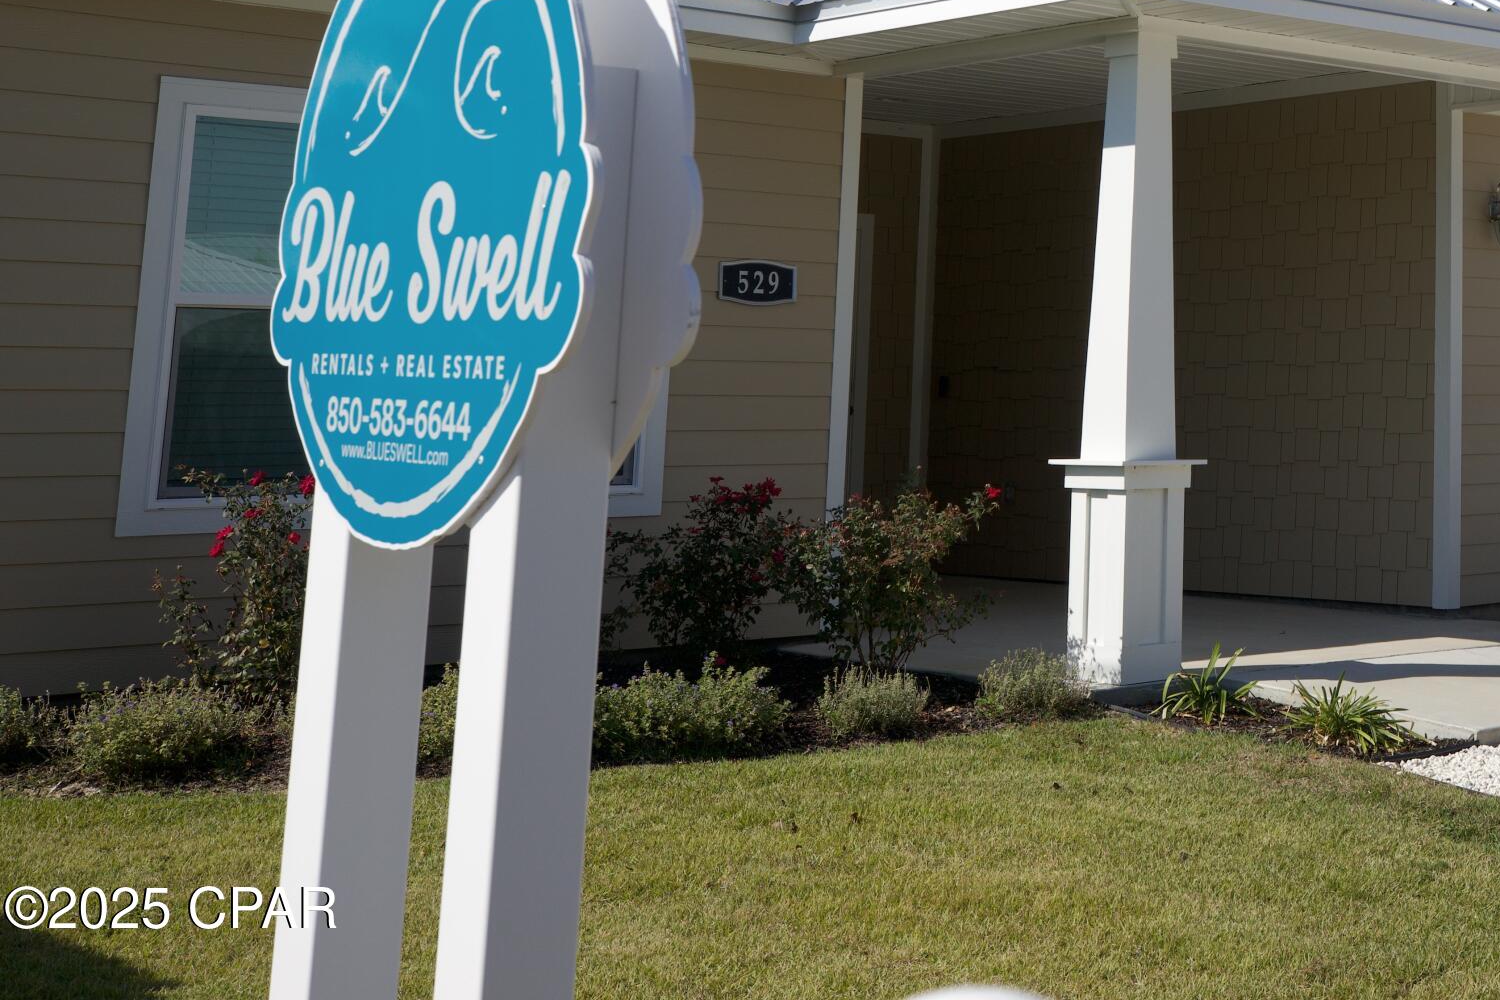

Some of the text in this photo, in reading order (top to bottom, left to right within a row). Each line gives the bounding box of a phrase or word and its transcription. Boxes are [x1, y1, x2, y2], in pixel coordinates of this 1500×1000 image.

[282, 169, 571, 324] Blue Swell
[737, 270, 779, 294] 529
[311, 353, 374, 376] RENTALS
[395, 354, 435, 378] REAL
[442, 355, 505, 380] ESTATE
[326, 396, 471, 441] 850-583-6644
[341, 441, 448, 466] www.BLUESWELL.com
